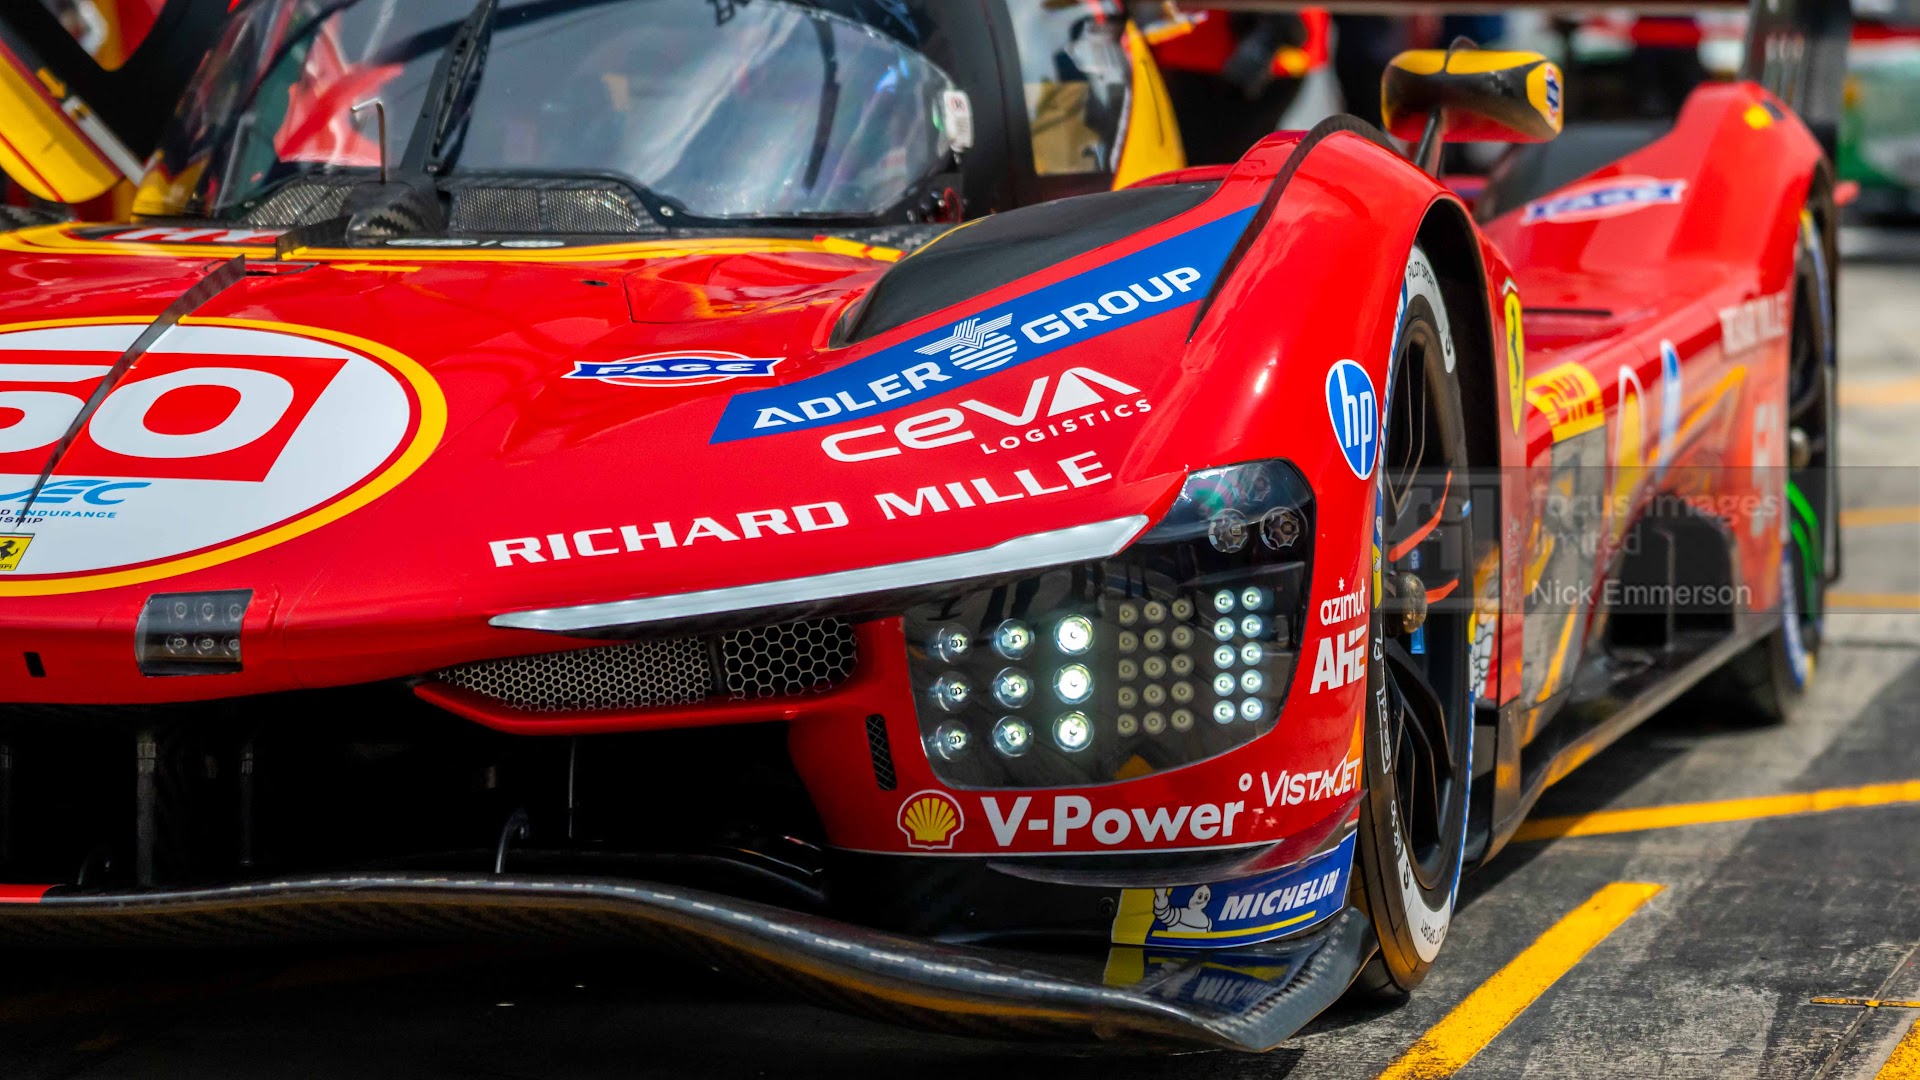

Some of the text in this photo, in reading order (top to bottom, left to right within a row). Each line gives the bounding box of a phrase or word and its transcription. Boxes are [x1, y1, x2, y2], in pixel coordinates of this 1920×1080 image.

[753, 266, 1201, 429] ADLER GROUP
[980, 398, 1152, 455] LOGISTICS
[1336, 363, 1373, 476] hp
[15, 509, 118, 519] ENDURANCE
[488, 450, 1113, 569] RICHARD MILLE
[1320, 578, 1366, 626] azimut
[980, 795, 1245, 847] V-Power
[1218, 868, 1341, 922] MICHELIN
